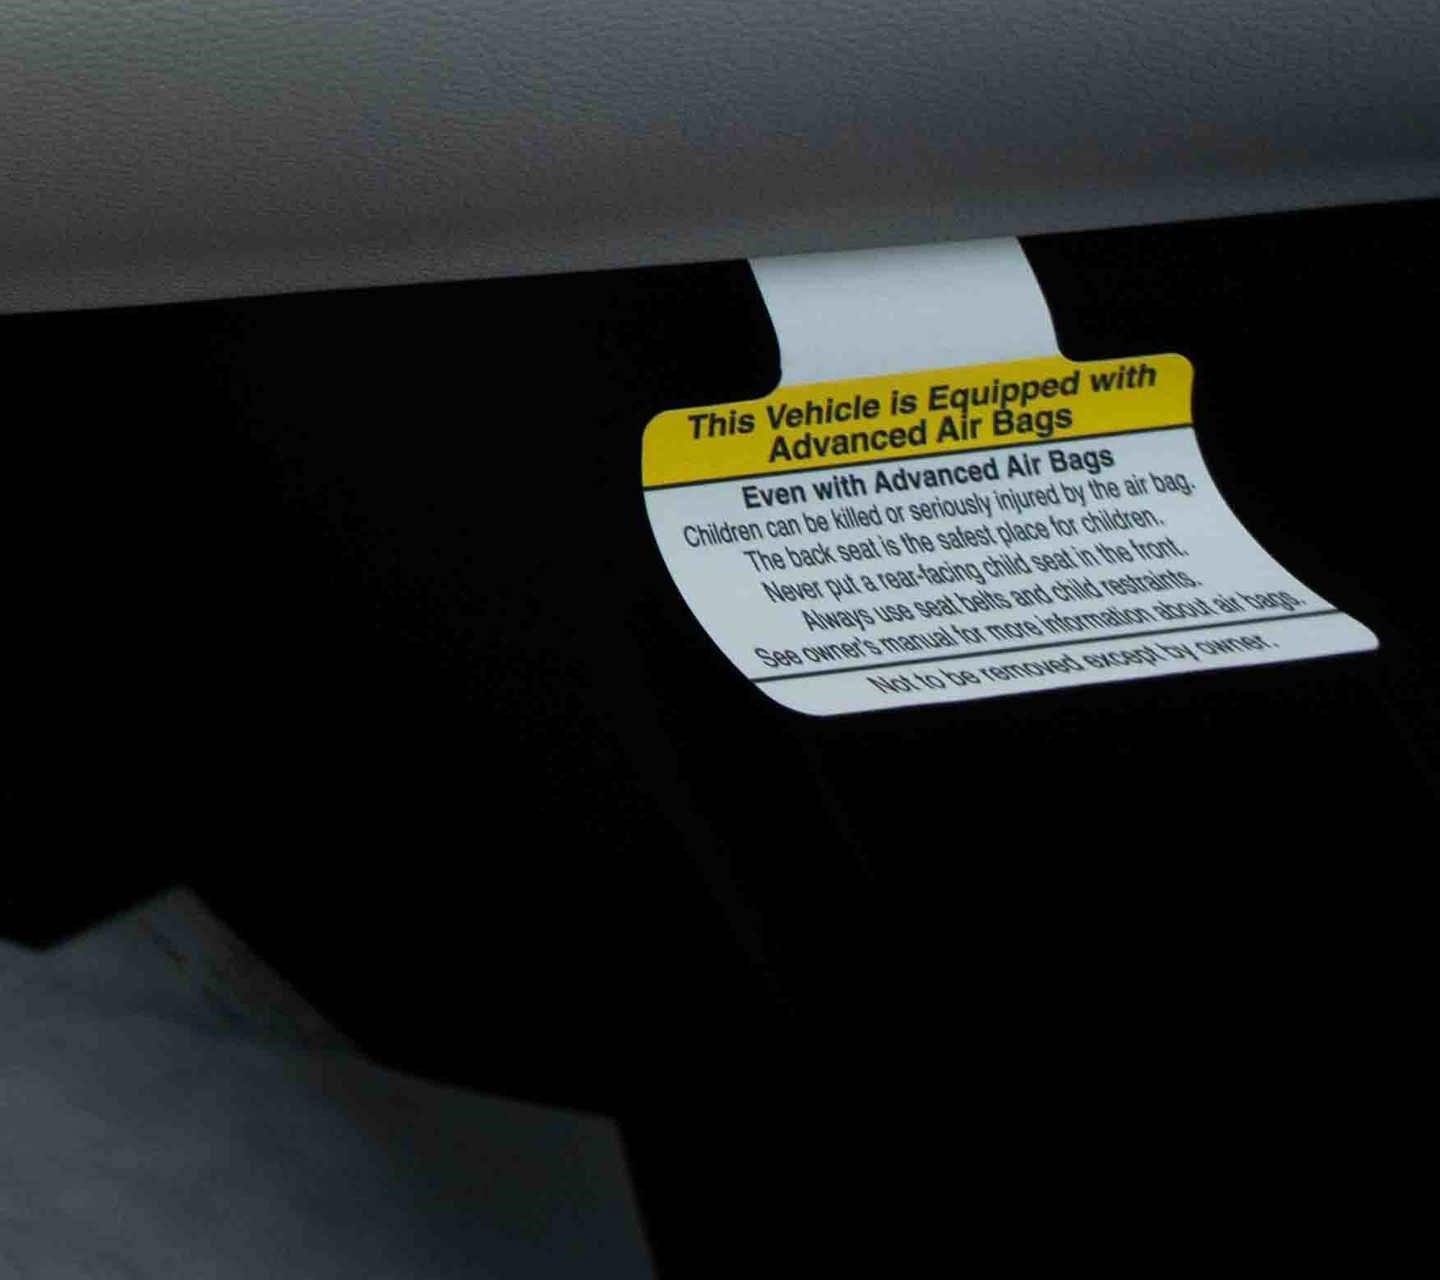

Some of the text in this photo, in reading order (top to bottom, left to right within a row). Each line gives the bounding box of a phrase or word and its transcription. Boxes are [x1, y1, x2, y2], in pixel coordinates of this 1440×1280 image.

[688, 363, 1157, 440] This Vehicle is Equipped with
[769, 407, 1073, 463] Advanced Air Bags
[683, 473, 1196, 548] Children can be killed or seriously injured by the air bag.
[741, 449, 1115, 509] Even with Advanced Air Bags
[743, 508, 1164, 572] The back seat is the safest place for children.
[761, 537, 1189, 604] Never put a rear-facing child seat in the front.
[754, 591, 1306, 668] See owner's manual for more information about air bags.
[801, 569, 1202, 632] Always use seat belts and child restraints.
[866, 635, 1278, 694] Not to be removed except by owner.
